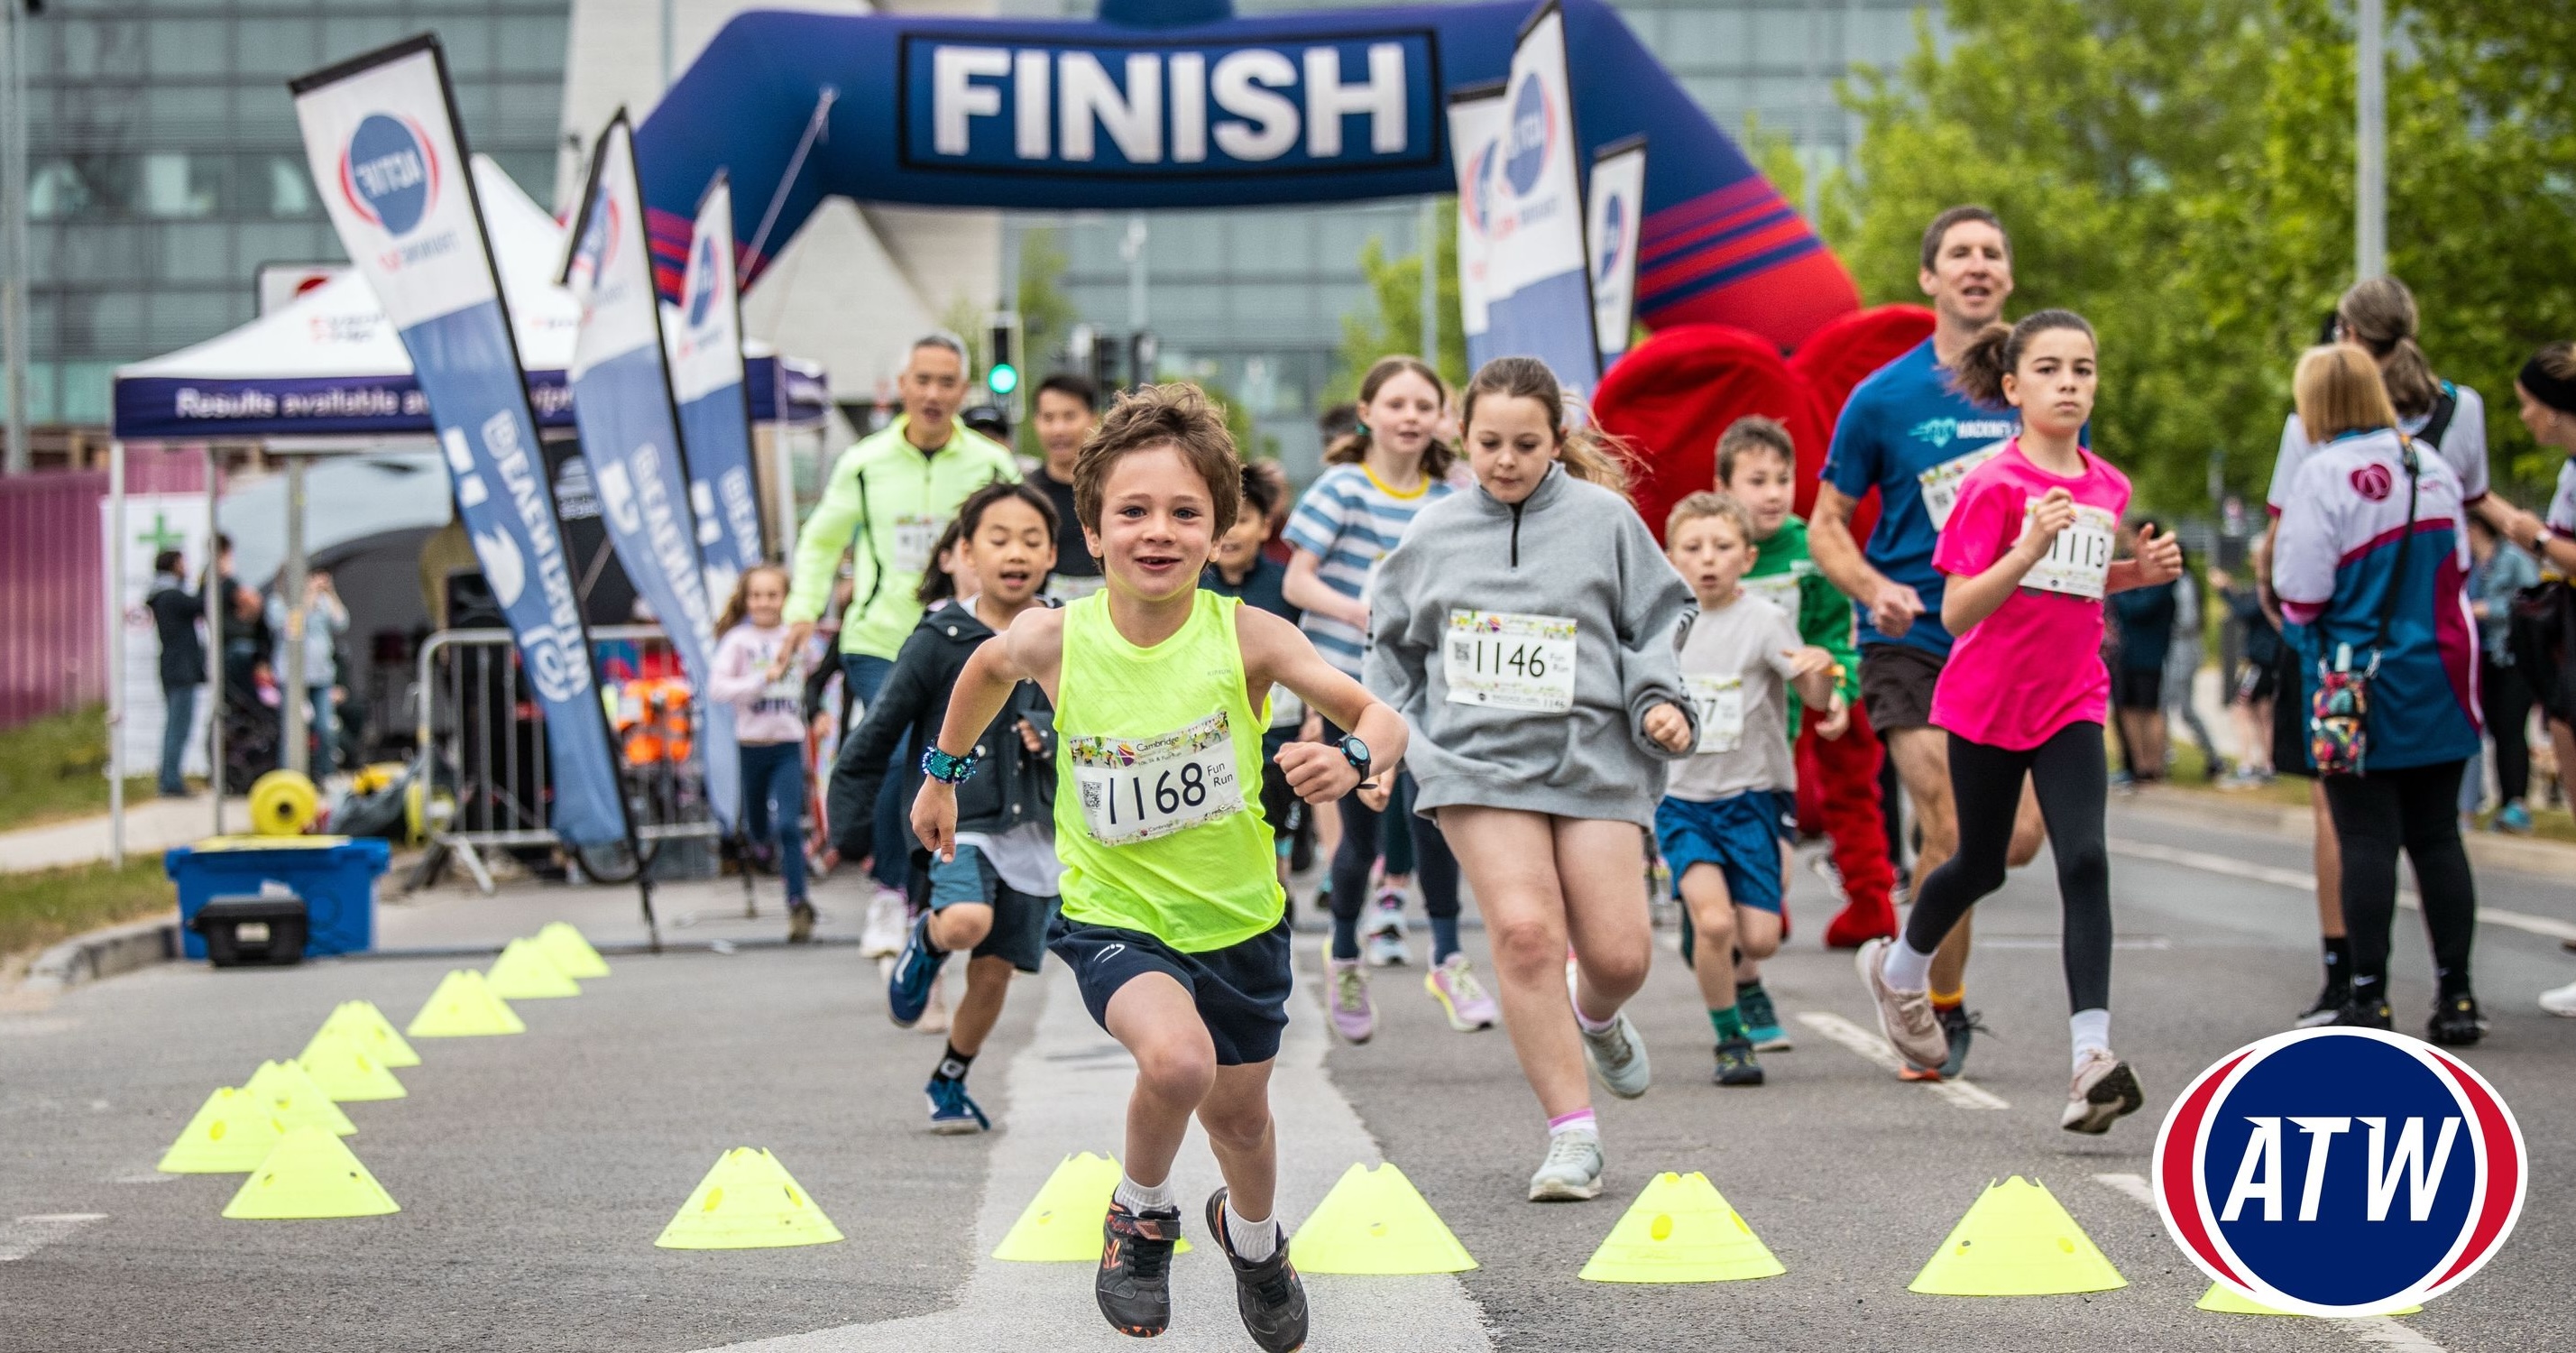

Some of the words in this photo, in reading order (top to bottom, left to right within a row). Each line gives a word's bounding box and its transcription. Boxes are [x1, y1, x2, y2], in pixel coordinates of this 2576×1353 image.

[933, 42, 1408, 164] FINISH
[175, 387, 278, 419] Results
[281, 385, 400, 418] available
[1477, 640, 1545, 677] 1146
[1136, 735, 1180, 752] Cambridge
[1207, 762, 1226, 777] Fun
[1212, 773, 1234, 787] Run
[1109, 762, 1206, 824] 1168
